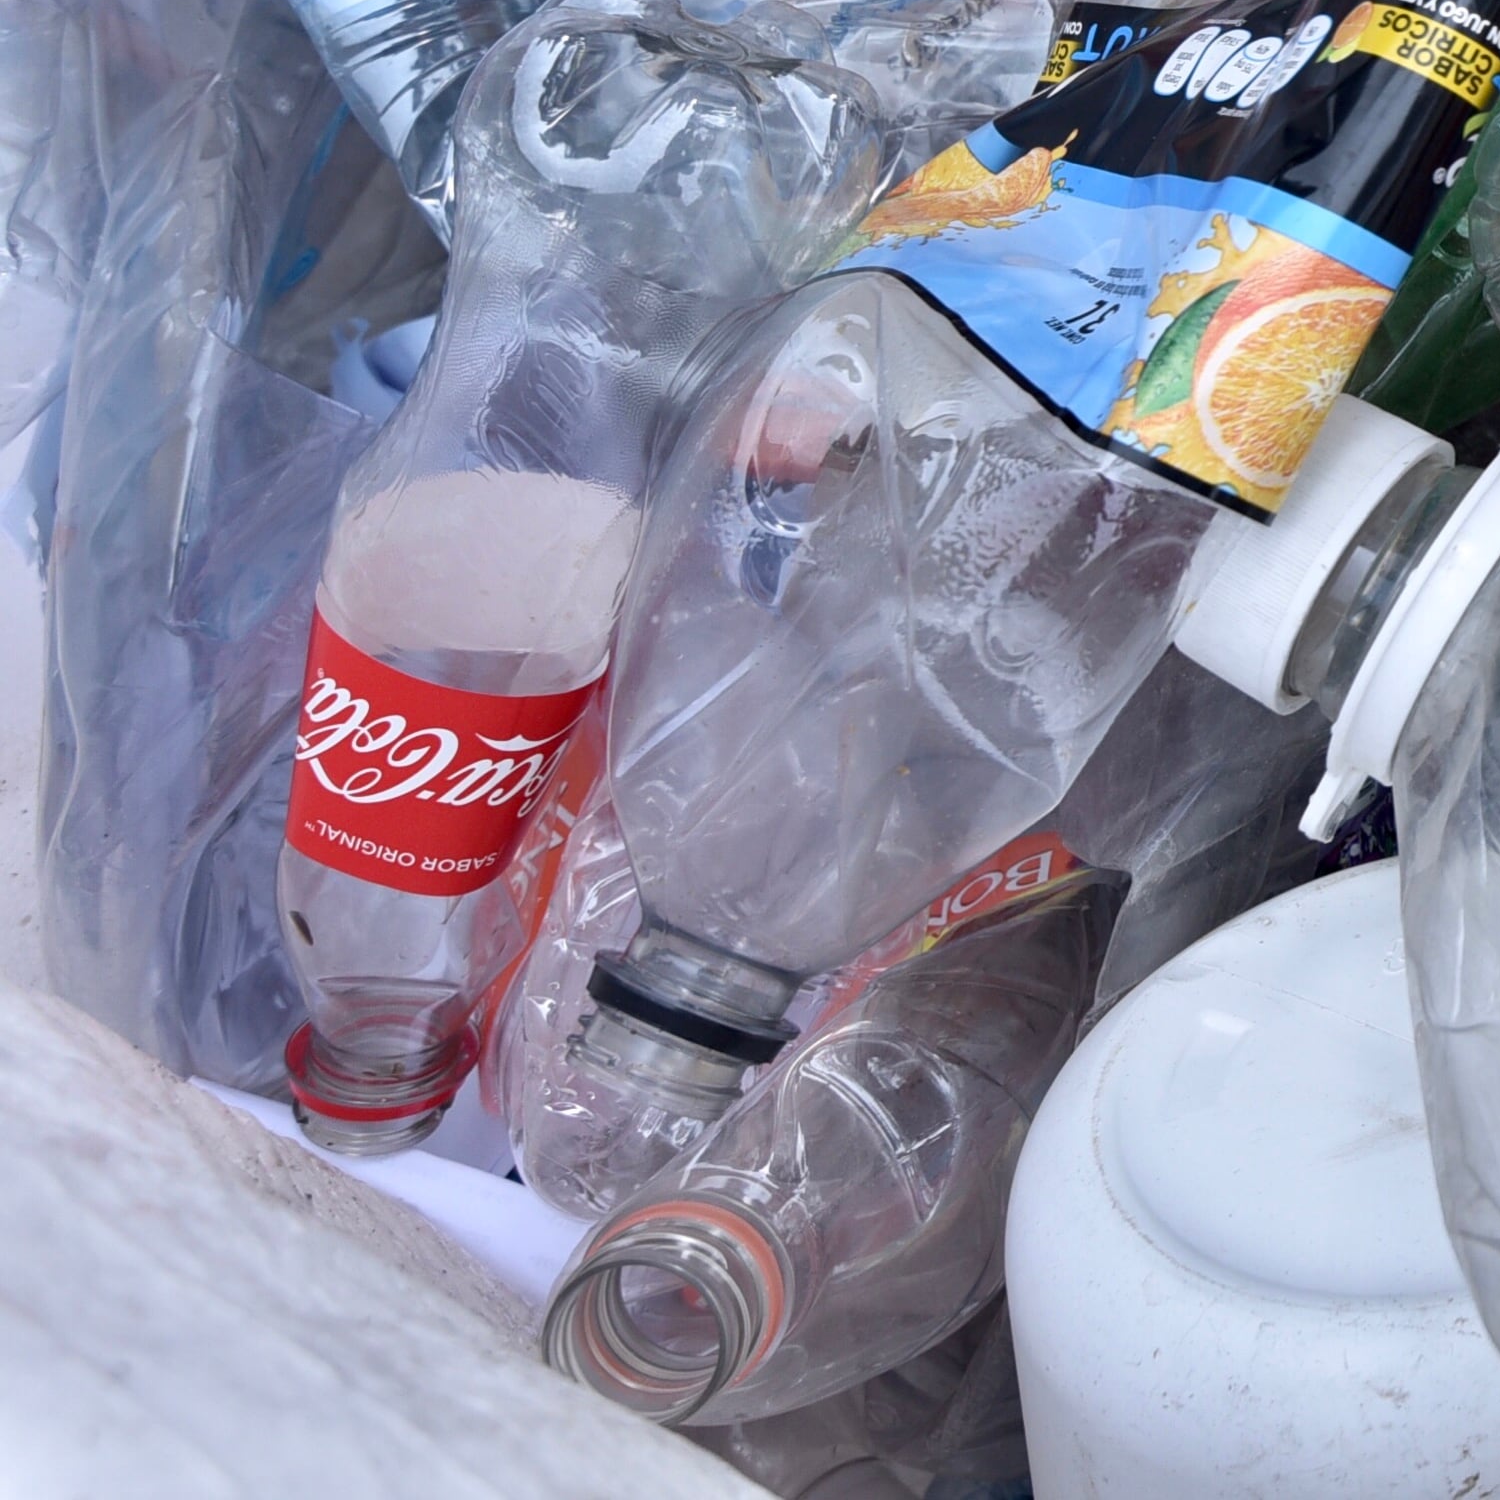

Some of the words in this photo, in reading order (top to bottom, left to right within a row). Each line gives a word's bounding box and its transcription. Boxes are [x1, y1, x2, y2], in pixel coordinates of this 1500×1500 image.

[1070, 13, 1135, 72] UT
[1392, 36, 1486, 97] SABOR
[418, 835, 498, 884] SABOR
